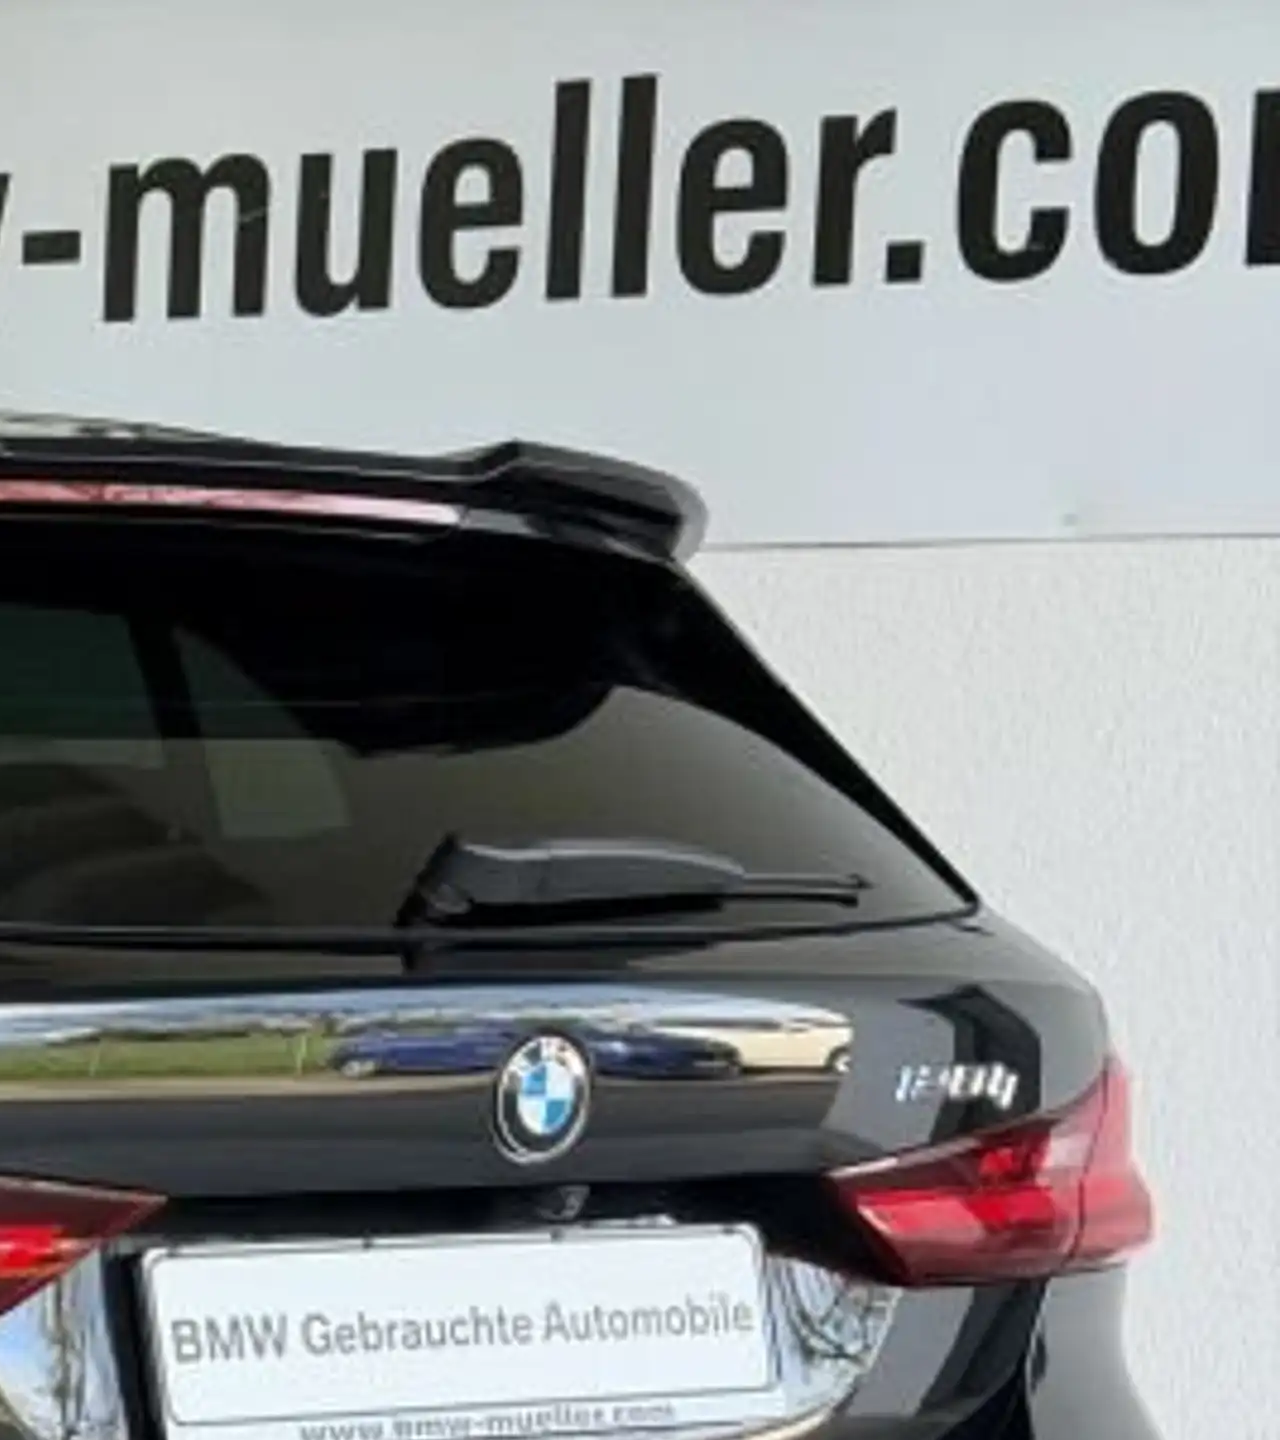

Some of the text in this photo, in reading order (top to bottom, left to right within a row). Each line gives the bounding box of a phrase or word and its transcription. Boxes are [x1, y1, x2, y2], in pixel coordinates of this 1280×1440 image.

[171, 1293, 755, 1365] BMW Gebrauchte Automobile
